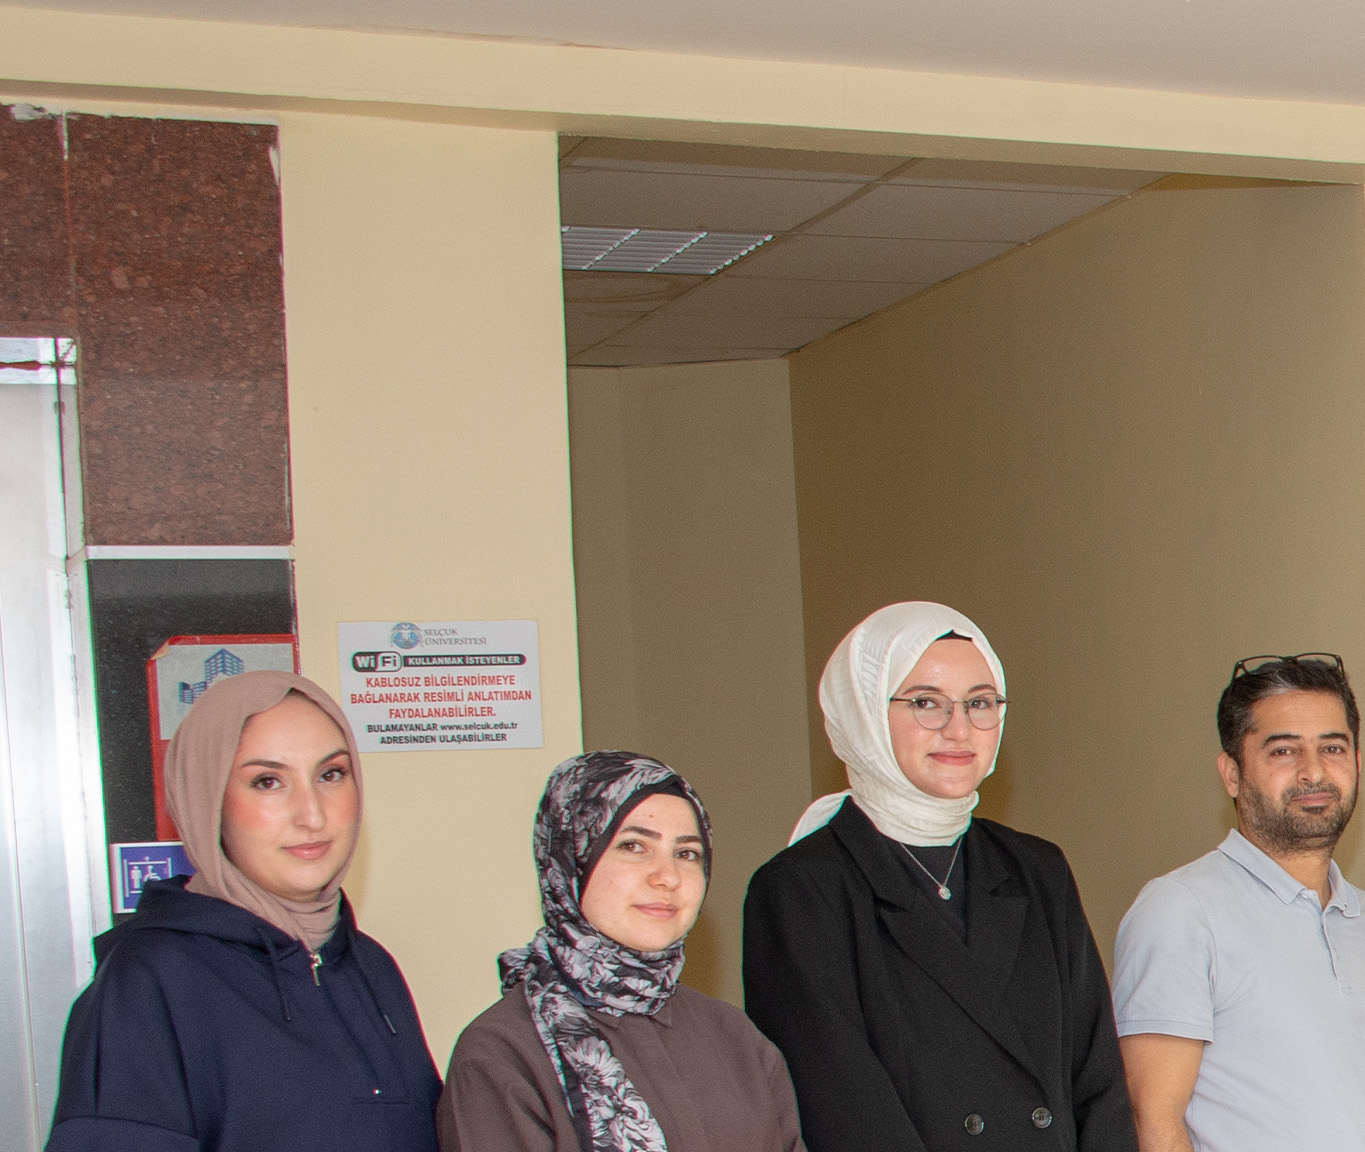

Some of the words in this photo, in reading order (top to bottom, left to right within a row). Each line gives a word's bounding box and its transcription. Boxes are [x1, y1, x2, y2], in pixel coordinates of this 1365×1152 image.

[424, 627, 459, 639] SELÇUK
[425, 636, 487, 646] ÜNİVERSİTESİ
[408, 655, 464, 666] KULLANMAK
[465, 654, 521, 665] İSTEYENLER
[366, 676, 421, 688] KABLOSUZ
[424, 673, 516, 687] BİLGİLENDİRMEYE
[351, 690, 421, 704] BAĞLANARAK
[424, 689, 464, 703] RESİMLİ
[467, 690, 532, 702] ANLATIMDAN
[389, 704, 497, 719] FAYDALANABİLİRLER.
[367, 723, 439, 733] BULAMAYANLAR
[440, 721, 518, 731] www.selcuk.edu.tr
[380, 733, 437, 745] ADRESİNDEN
[439, 732, 508, 745] ULAŞABİLİRLER
